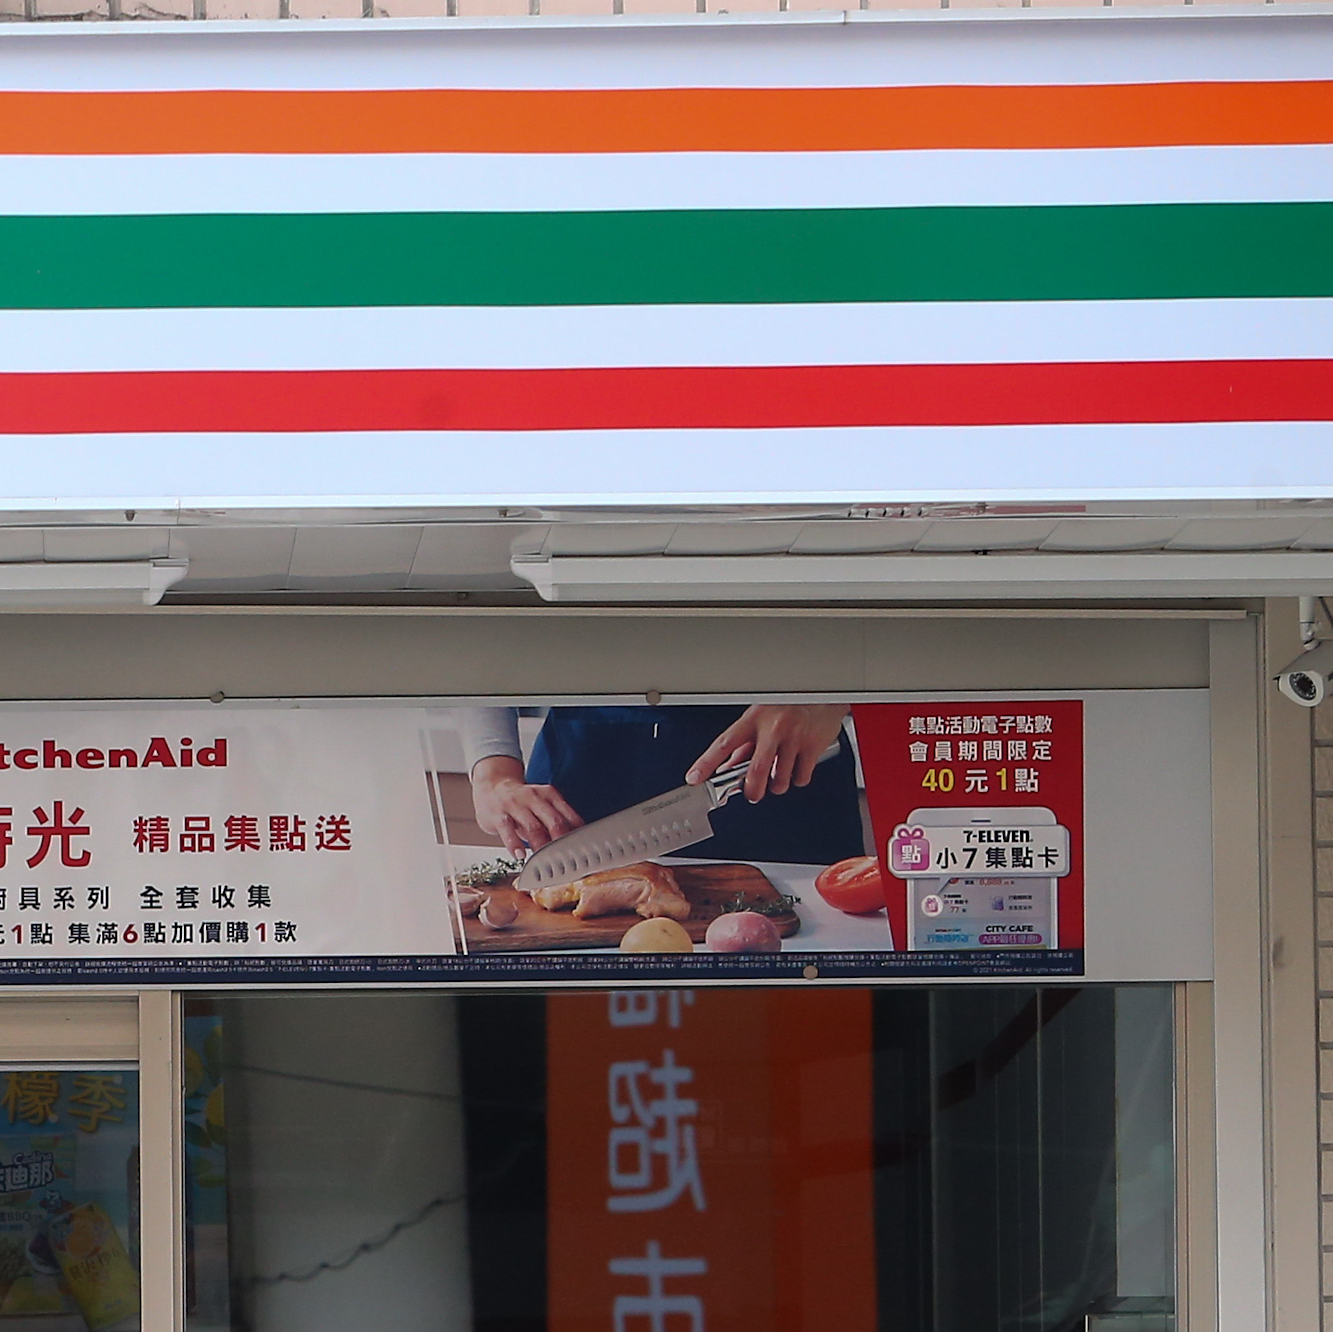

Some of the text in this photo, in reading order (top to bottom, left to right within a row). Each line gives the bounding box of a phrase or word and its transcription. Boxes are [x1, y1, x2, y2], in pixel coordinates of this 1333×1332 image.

[908, 715, 1053, 736] 集點活動電子點數
[908, 740, 1053, 763] 會員期間限定
[131, 813, 353, 855] 精品集點送
[935, 847, 1060, 870] 小7集點卡
[138, 883, 273, 911] 全套收集
[67, 920, 298, 946] 集滿6點加價購1款
[985, 925, 1034, 933] CITY CAFE
